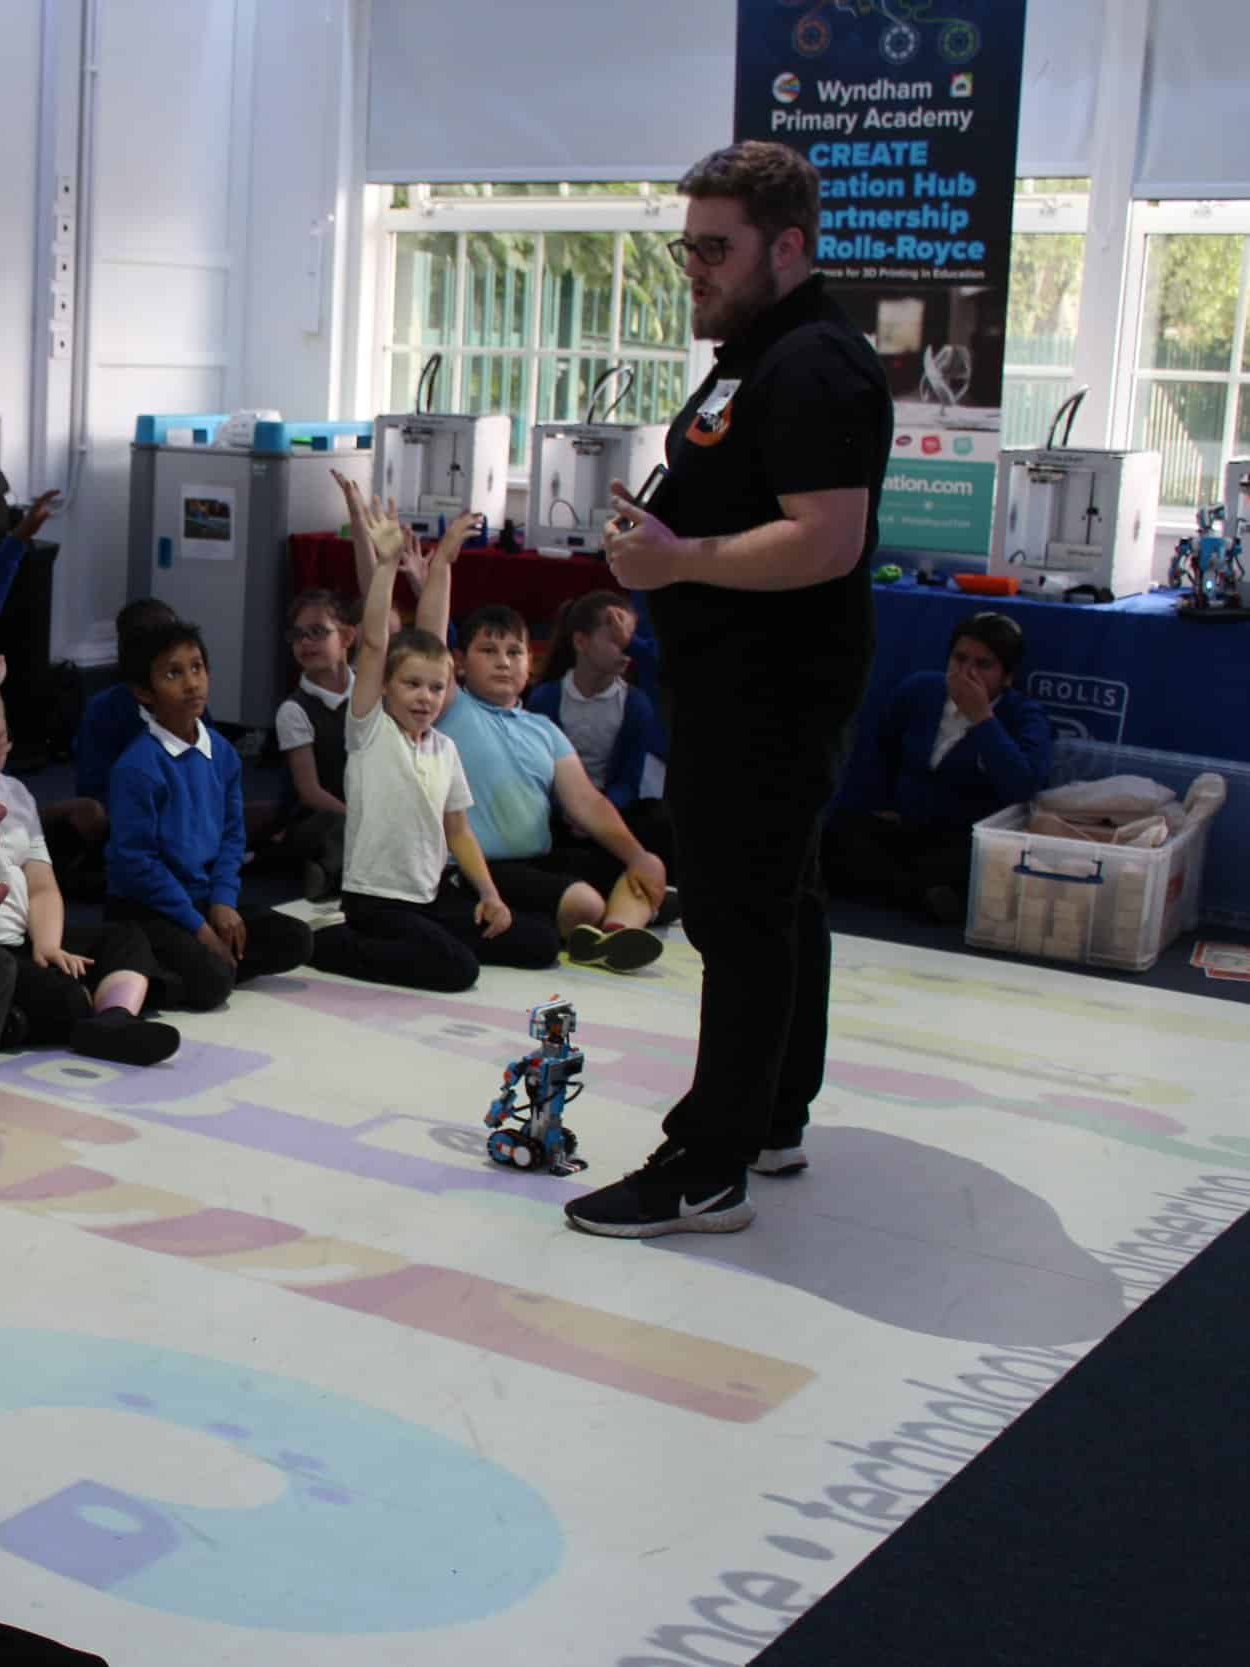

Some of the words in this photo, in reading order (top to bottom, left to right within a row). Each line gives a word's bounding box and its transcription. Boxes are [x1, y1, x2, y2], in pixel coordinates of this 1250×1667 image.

[817, 78, 932, 106] Wyndham
[771, 110, 858, 134] Primary
[863, 106, 974, 132] Academy
[808, 140, 928, 166] CREATE
[818, 171, 905, 197] cation
[914, 171, 976, 197] Hub
[819, 202, 969, 234] artnership
[817, 235, 985, 266] Rolls-Royce
[933, 268, 985, 279] Education
[883, 474, 974, 496] ation.com
